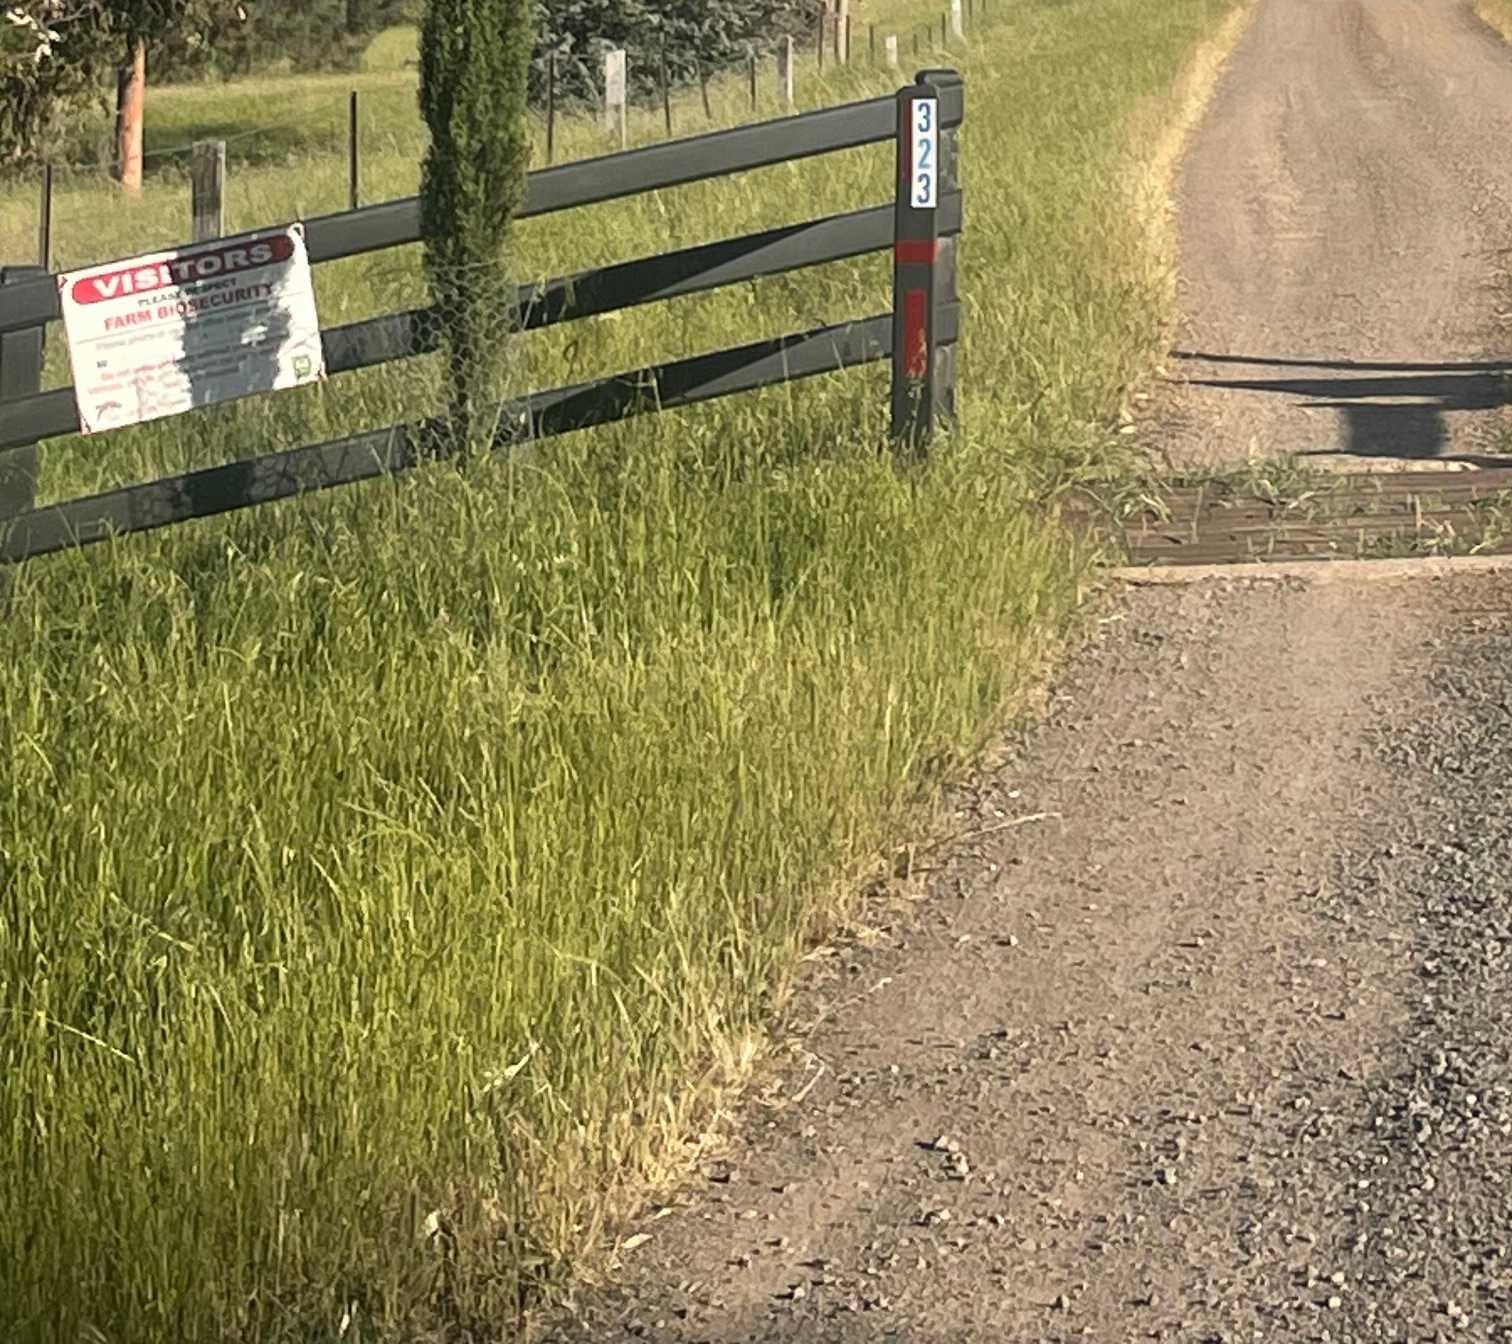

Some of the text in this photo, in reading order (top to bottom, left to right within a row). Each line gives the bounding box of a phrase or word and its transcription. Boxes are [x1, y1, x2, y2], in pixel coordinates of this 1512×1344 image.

[917, 101, 932, 204] 323
[93, 242, 273, 298] VISITORS
[104, 307, 152, 331] FARM
[157, 282, 274, 319] BIOSECURITY
